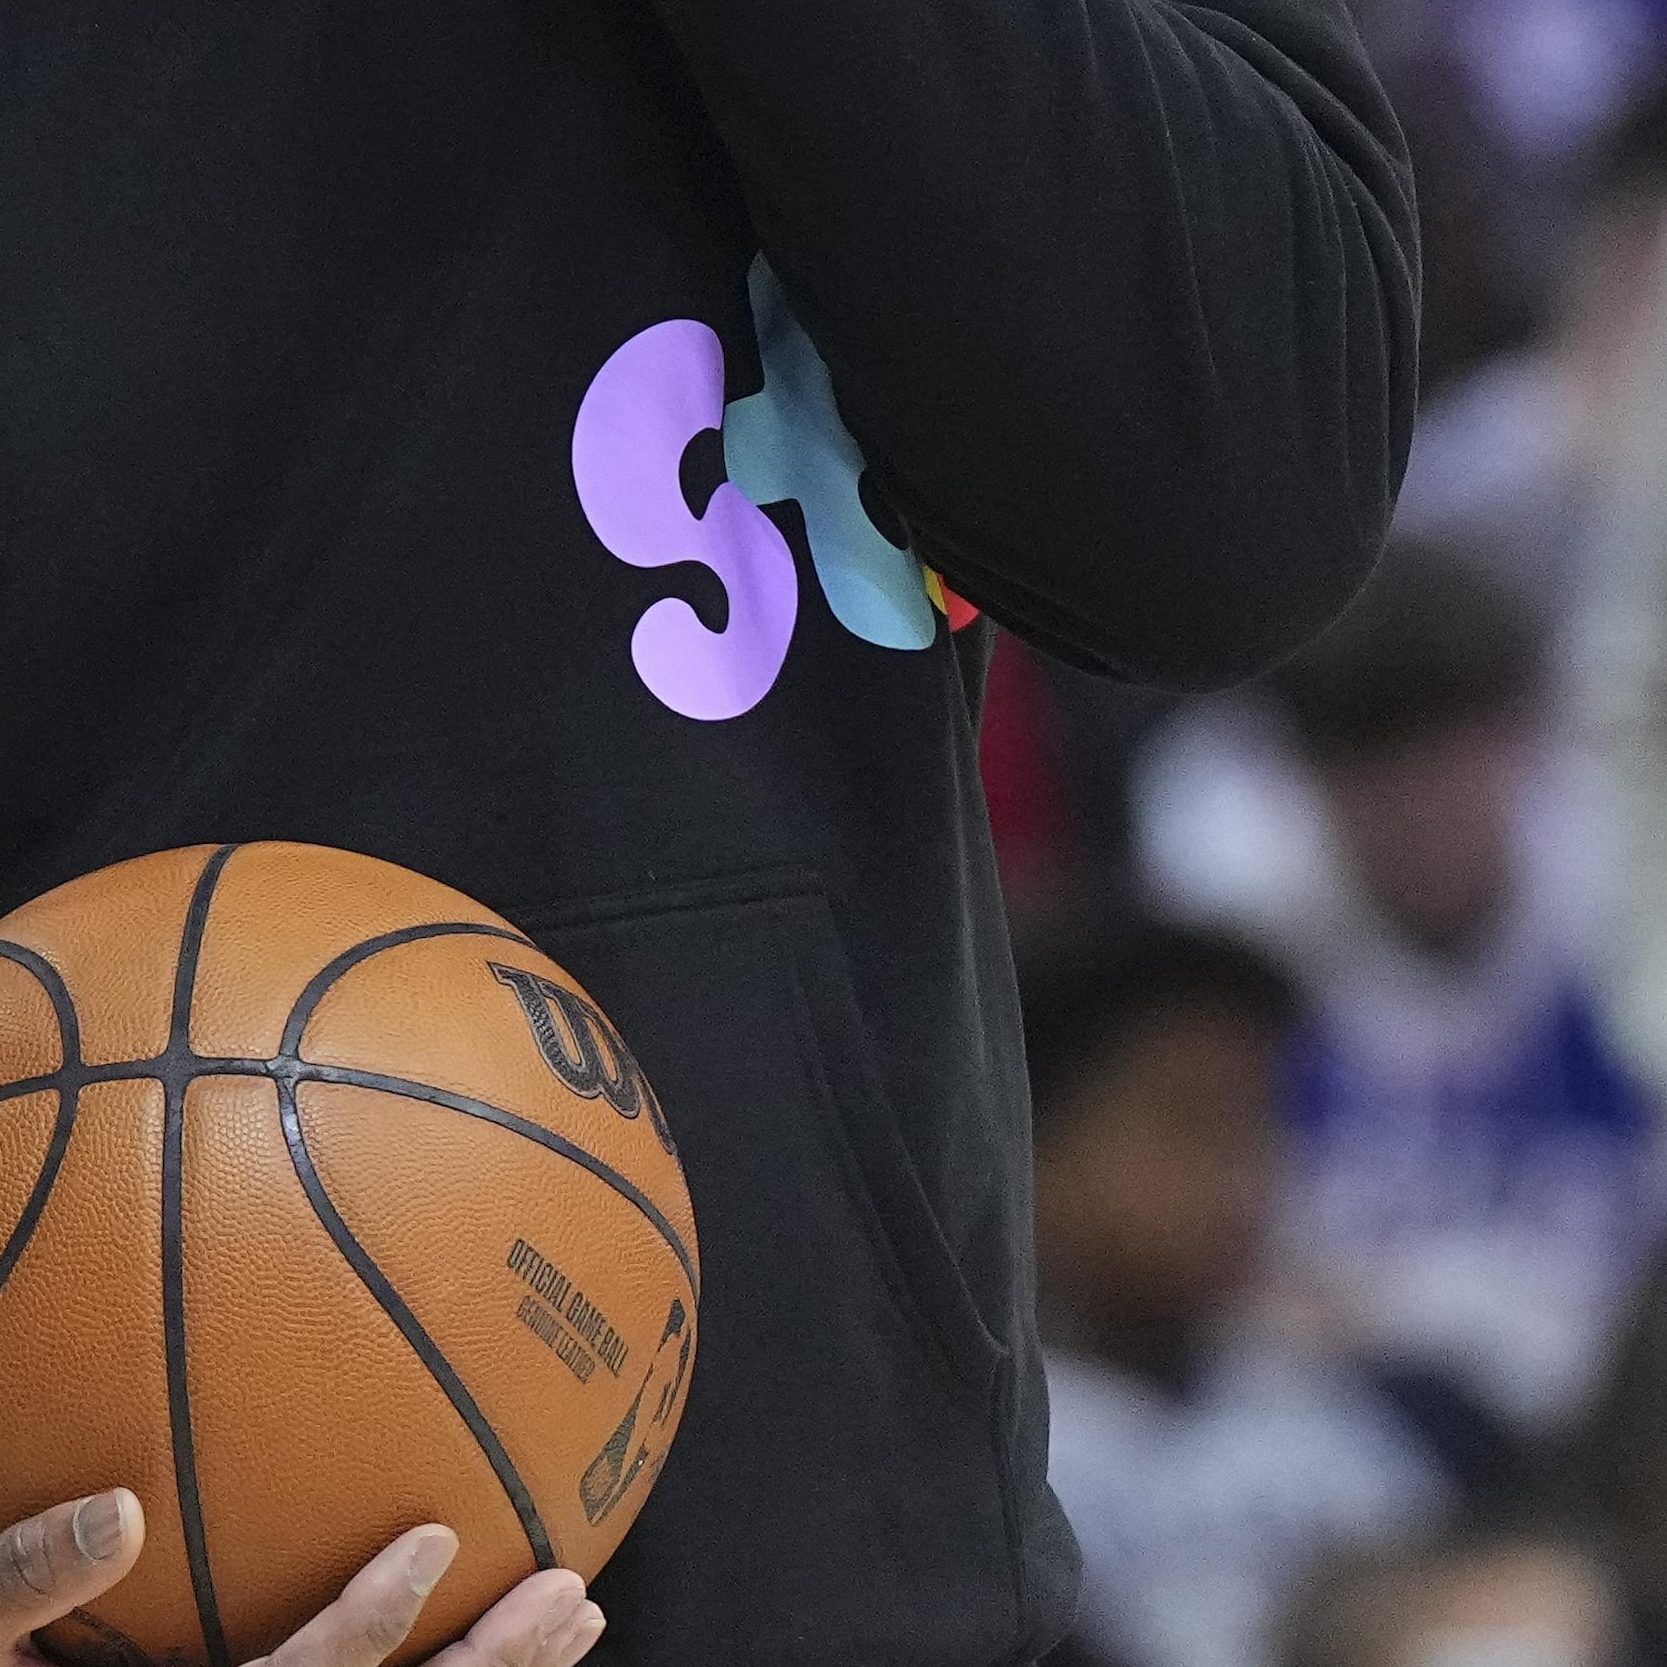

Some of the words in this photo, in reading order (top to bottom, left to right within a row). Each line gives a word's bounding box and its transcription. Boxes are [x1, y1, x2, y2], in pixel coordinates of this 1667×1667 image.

[507, 1239, 571, 1312] OFFICIAL
[566, 1291, 605, 1347] GAME
[597, 1327, 629, 1378] BALL
